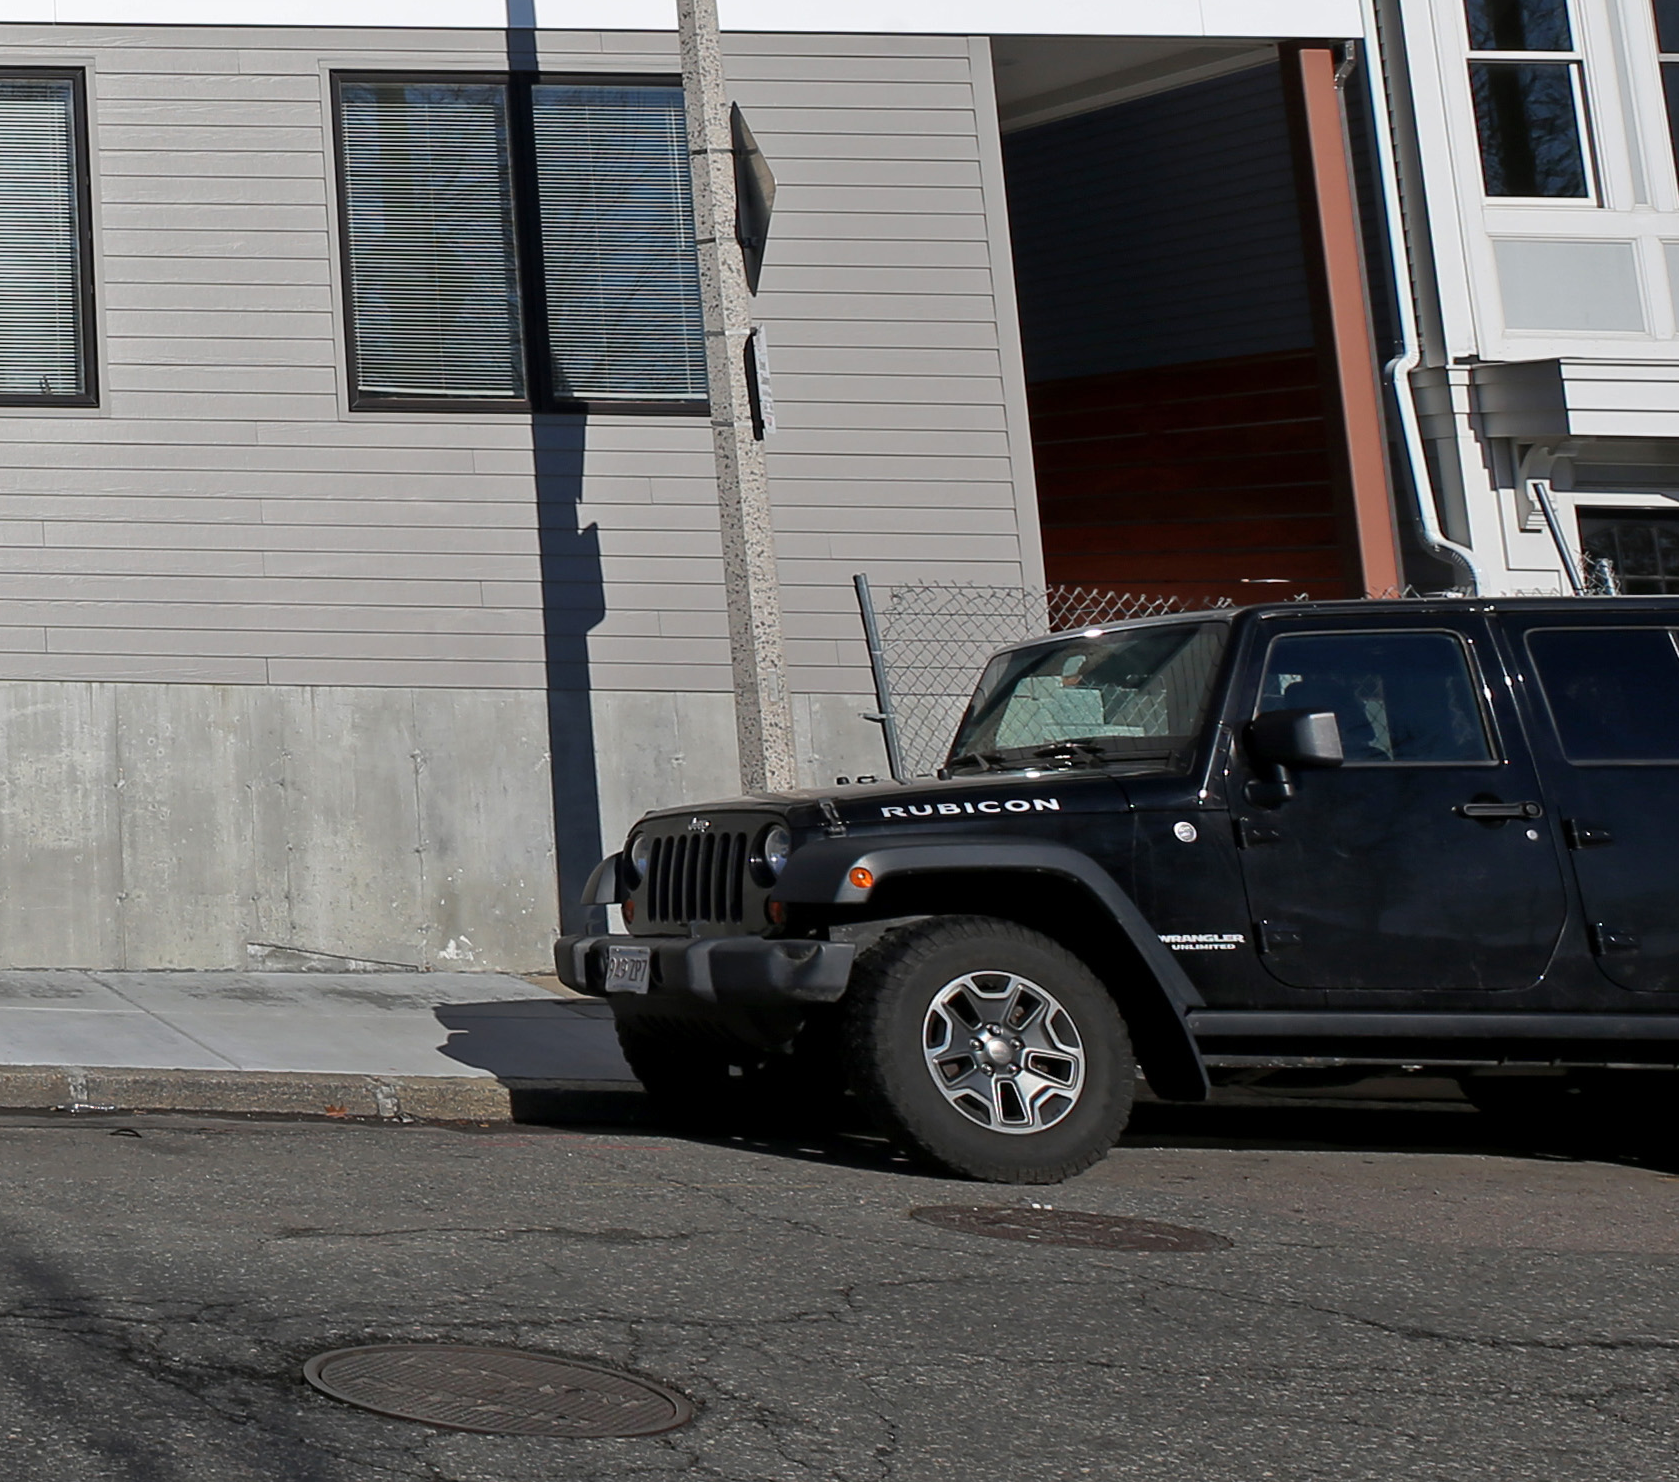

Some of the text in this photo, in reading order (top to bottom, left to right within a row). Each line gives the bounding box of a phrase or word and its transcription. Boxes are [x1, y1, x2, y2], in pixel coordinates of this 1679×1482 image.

[880, 798, 1061, 818] RUBICON
[1157, 933, 1246, 943] WRANGLER
[1170, 943, 1237, 951] UNLIMITED
